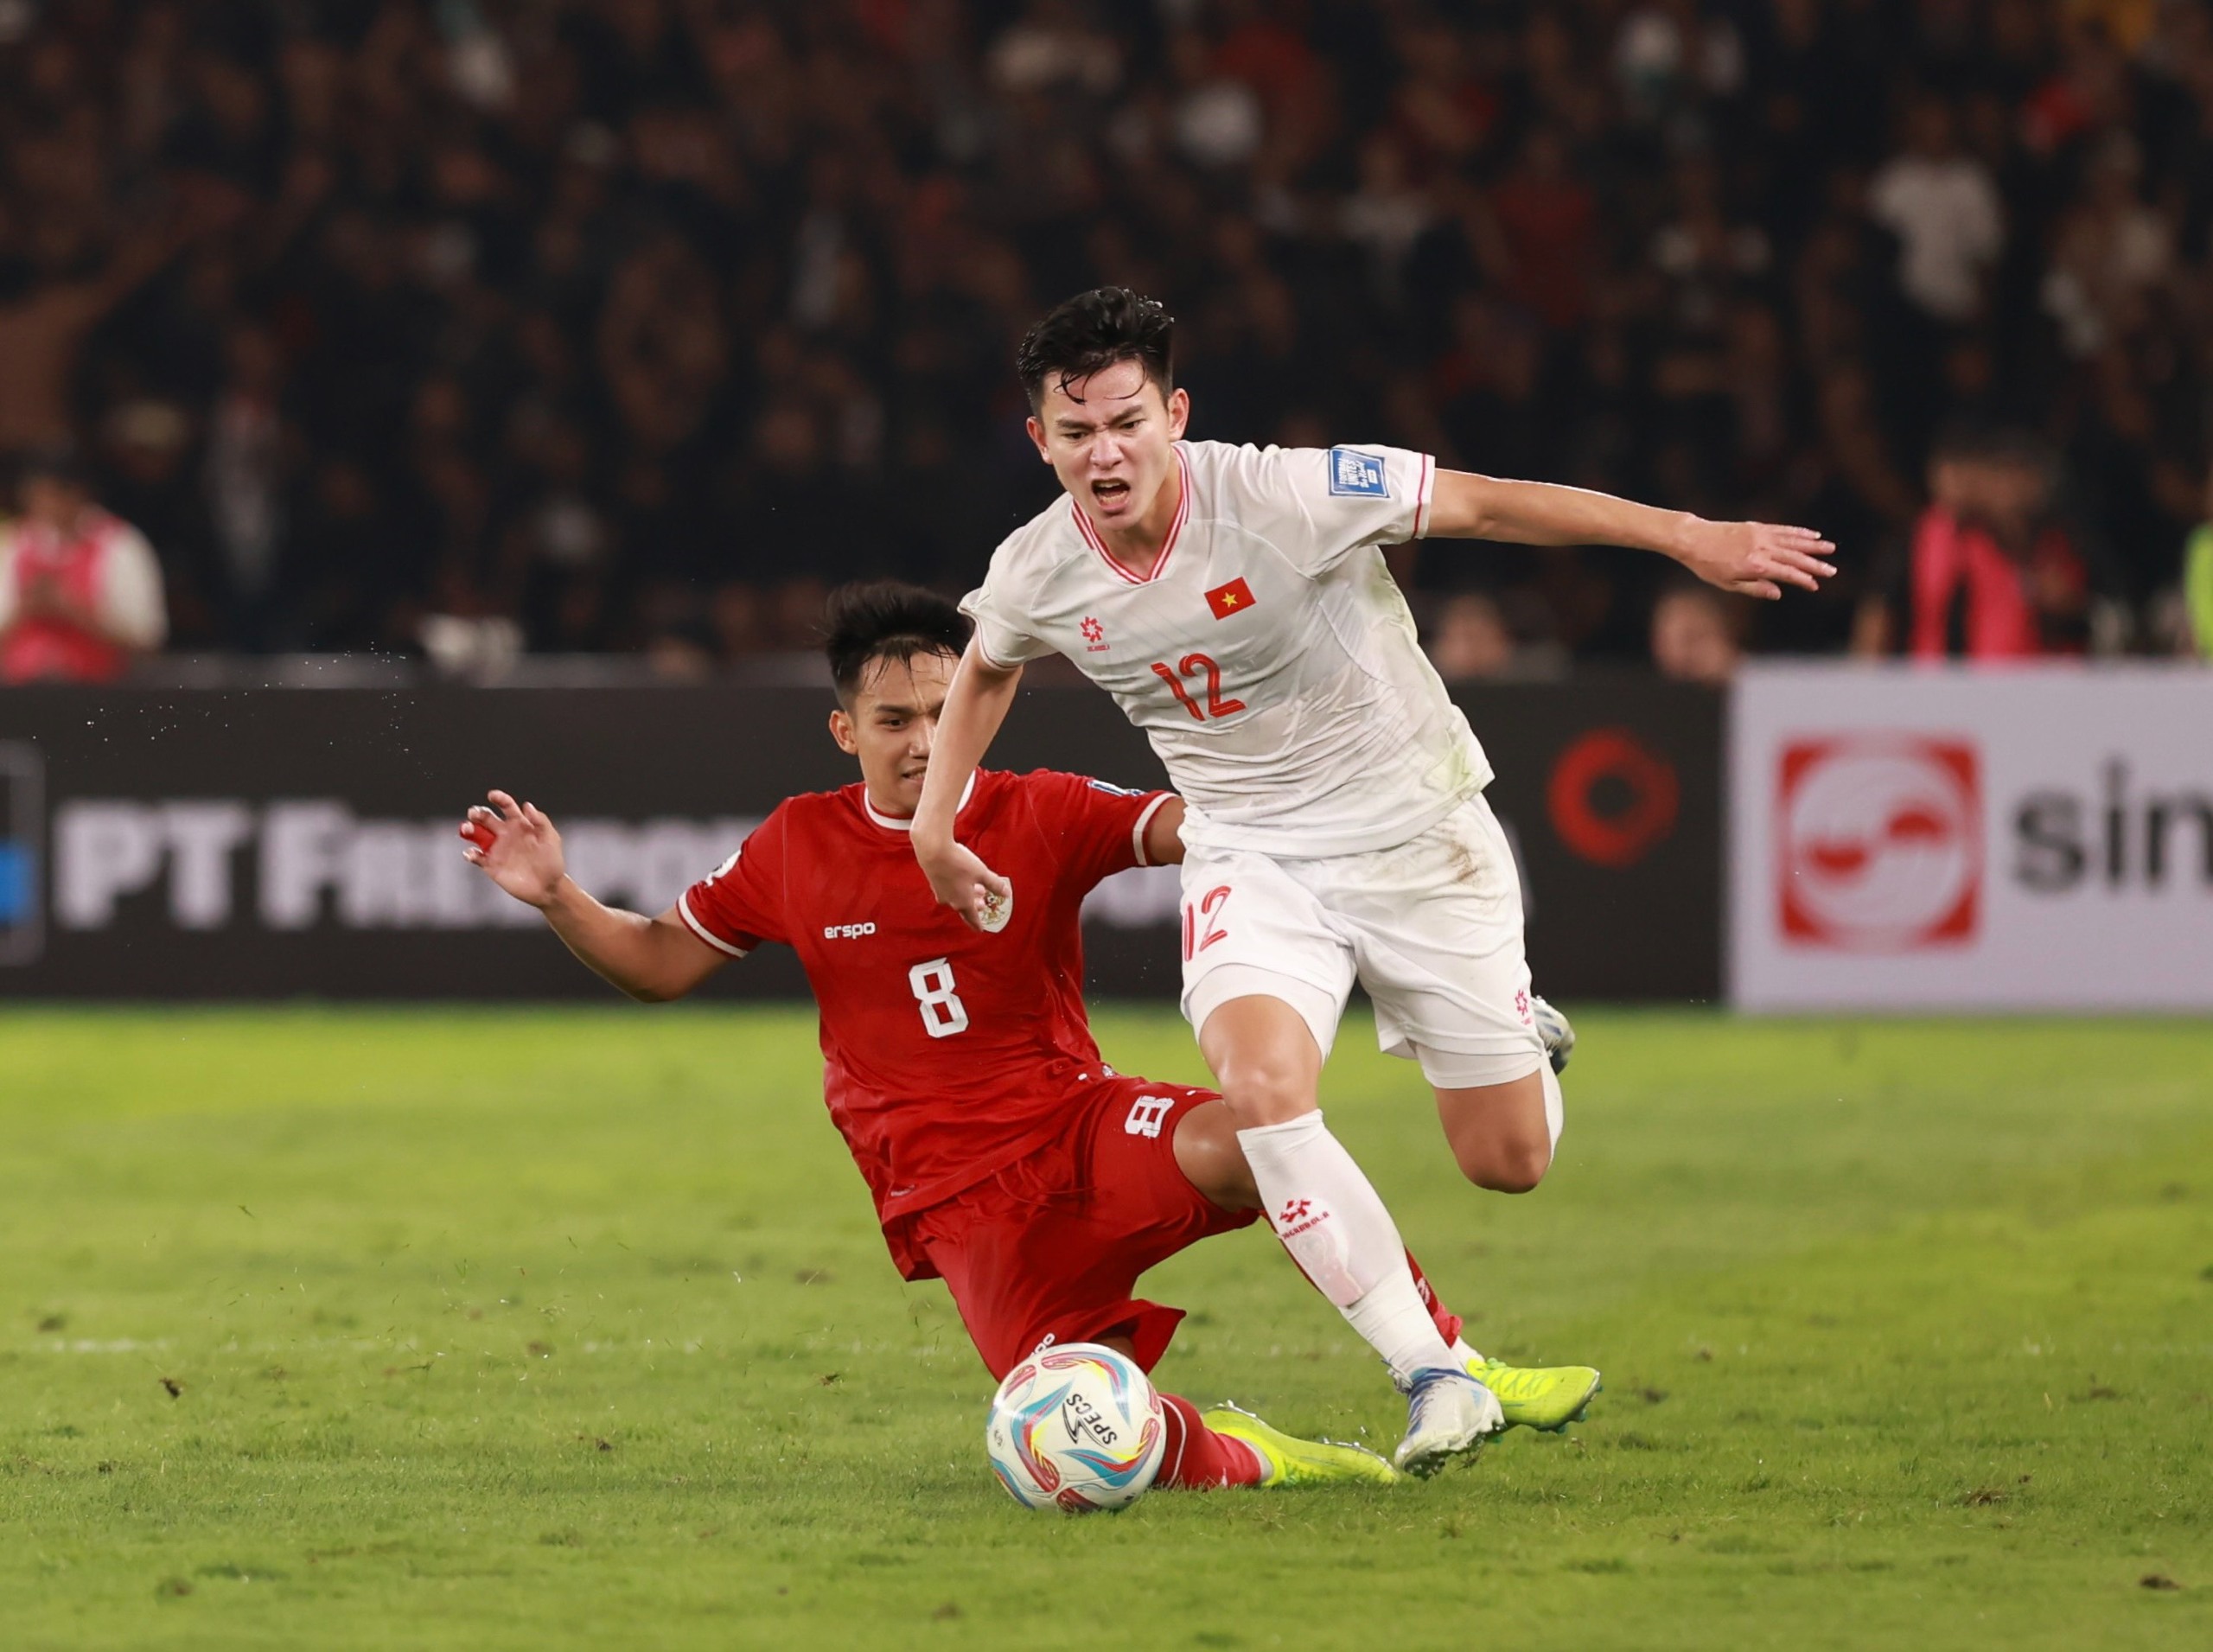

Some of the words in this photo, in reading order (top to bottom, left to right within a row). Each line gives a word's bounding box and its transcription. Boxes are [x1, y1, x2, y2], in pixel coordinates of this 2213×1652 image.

[1151, 653, 1247, 722] 12
[2012, 755, 2213, 896] sin
[54, 801, 247, 928] PT
[824, 922, 877, 940] erspo
[1182, 884, 1232, 962] 12
[909, 956, 970, 1038] 8
[1125, 1095, 1175, 1139] 8
[1066, 1394, 1118, 1445] SPECS
